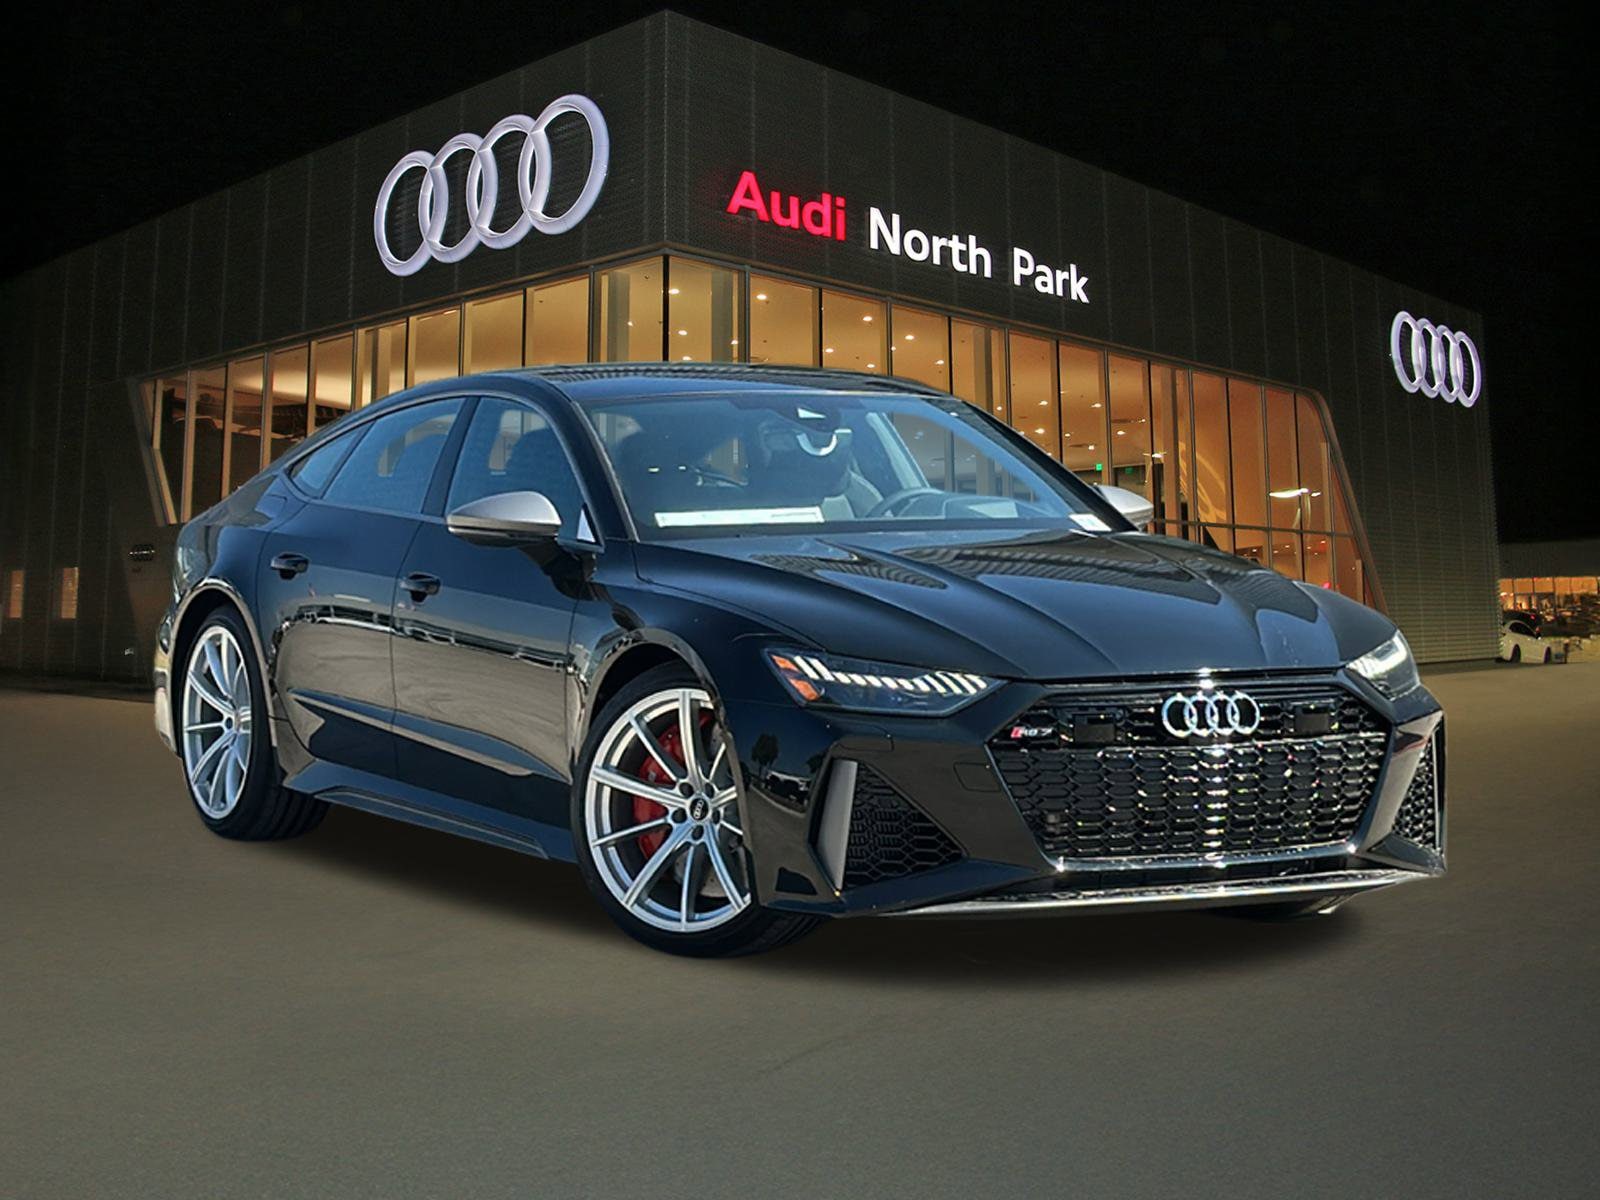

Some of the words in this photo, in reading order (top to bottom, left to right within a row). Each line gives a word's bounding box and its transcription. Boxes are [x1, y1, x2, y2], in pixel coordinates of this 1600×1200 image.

[726, 170, 846, 242] Audi
[869, 206, 992, 278] North
[1013, 247, 1090, 304] Park
